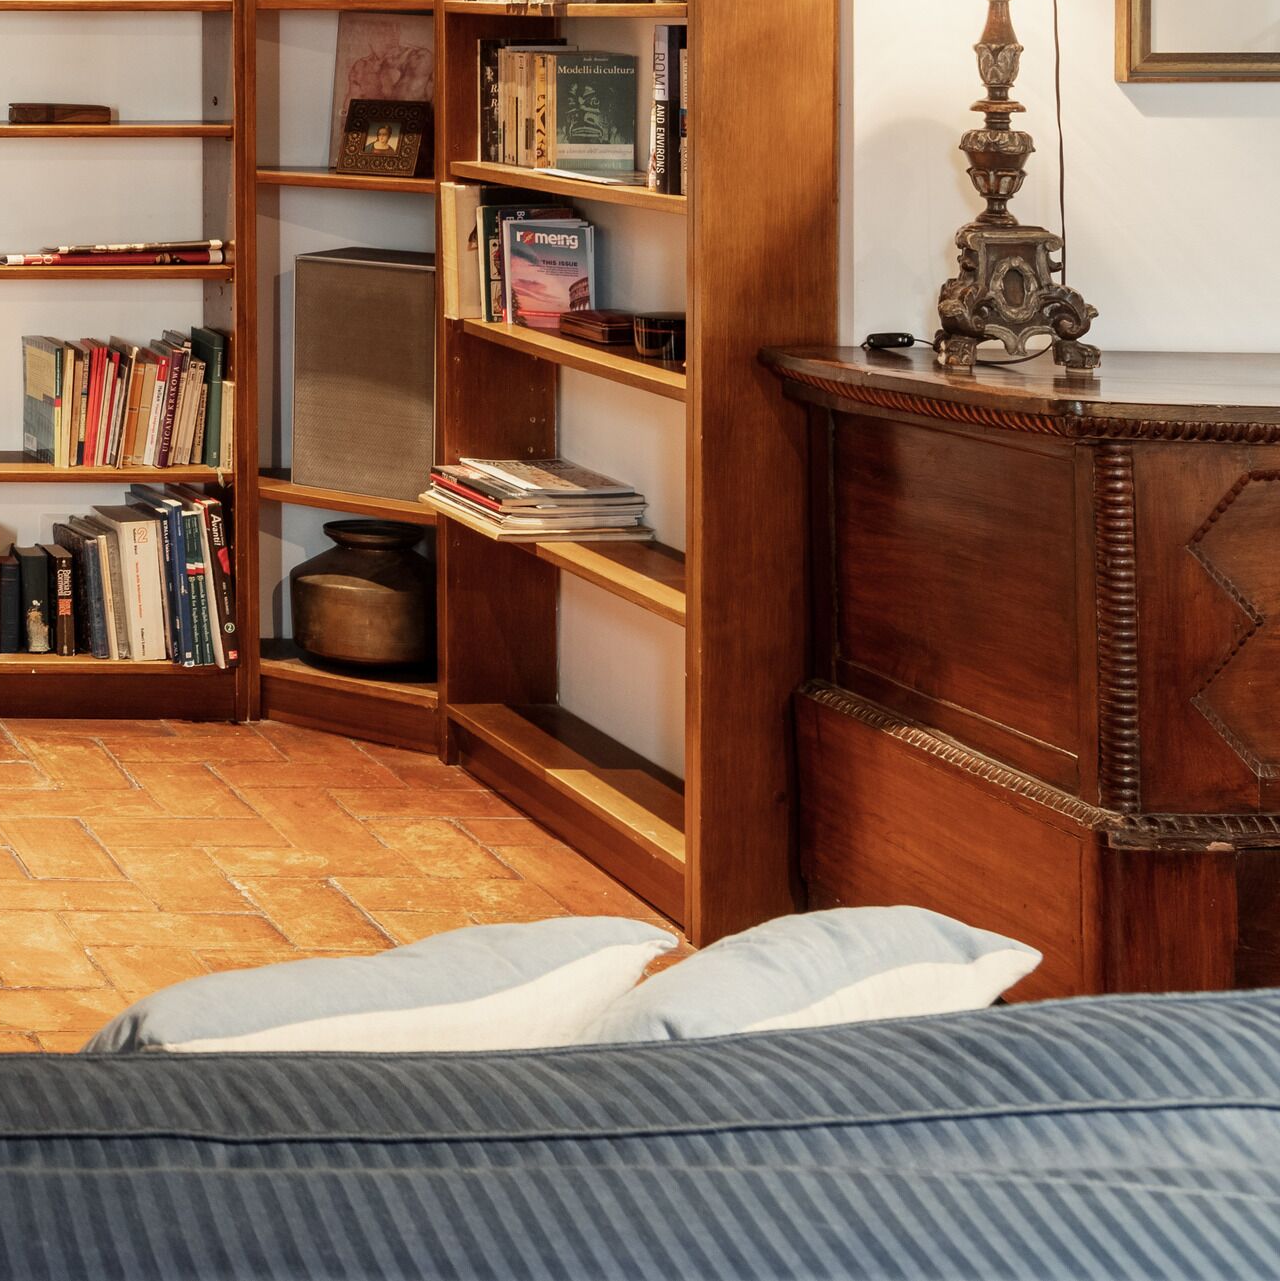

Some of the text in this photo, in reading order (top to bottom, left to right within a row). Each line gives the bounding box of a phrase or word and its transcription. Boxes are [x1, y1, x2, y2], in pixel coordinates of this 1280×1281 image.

[557, 64, 636, 75] Modelli di cultura
[655, 52, 666, 174] ROME AND ENVIRONS
[156, 385, 164, 402] Italian
[161, 365, 180, 452] ULICAMI KRAKOWA
[137, 527, 149, 543] 2
[210, 514, 222, 546] Avanti!
[63, 570, 71, 589] Patricia
